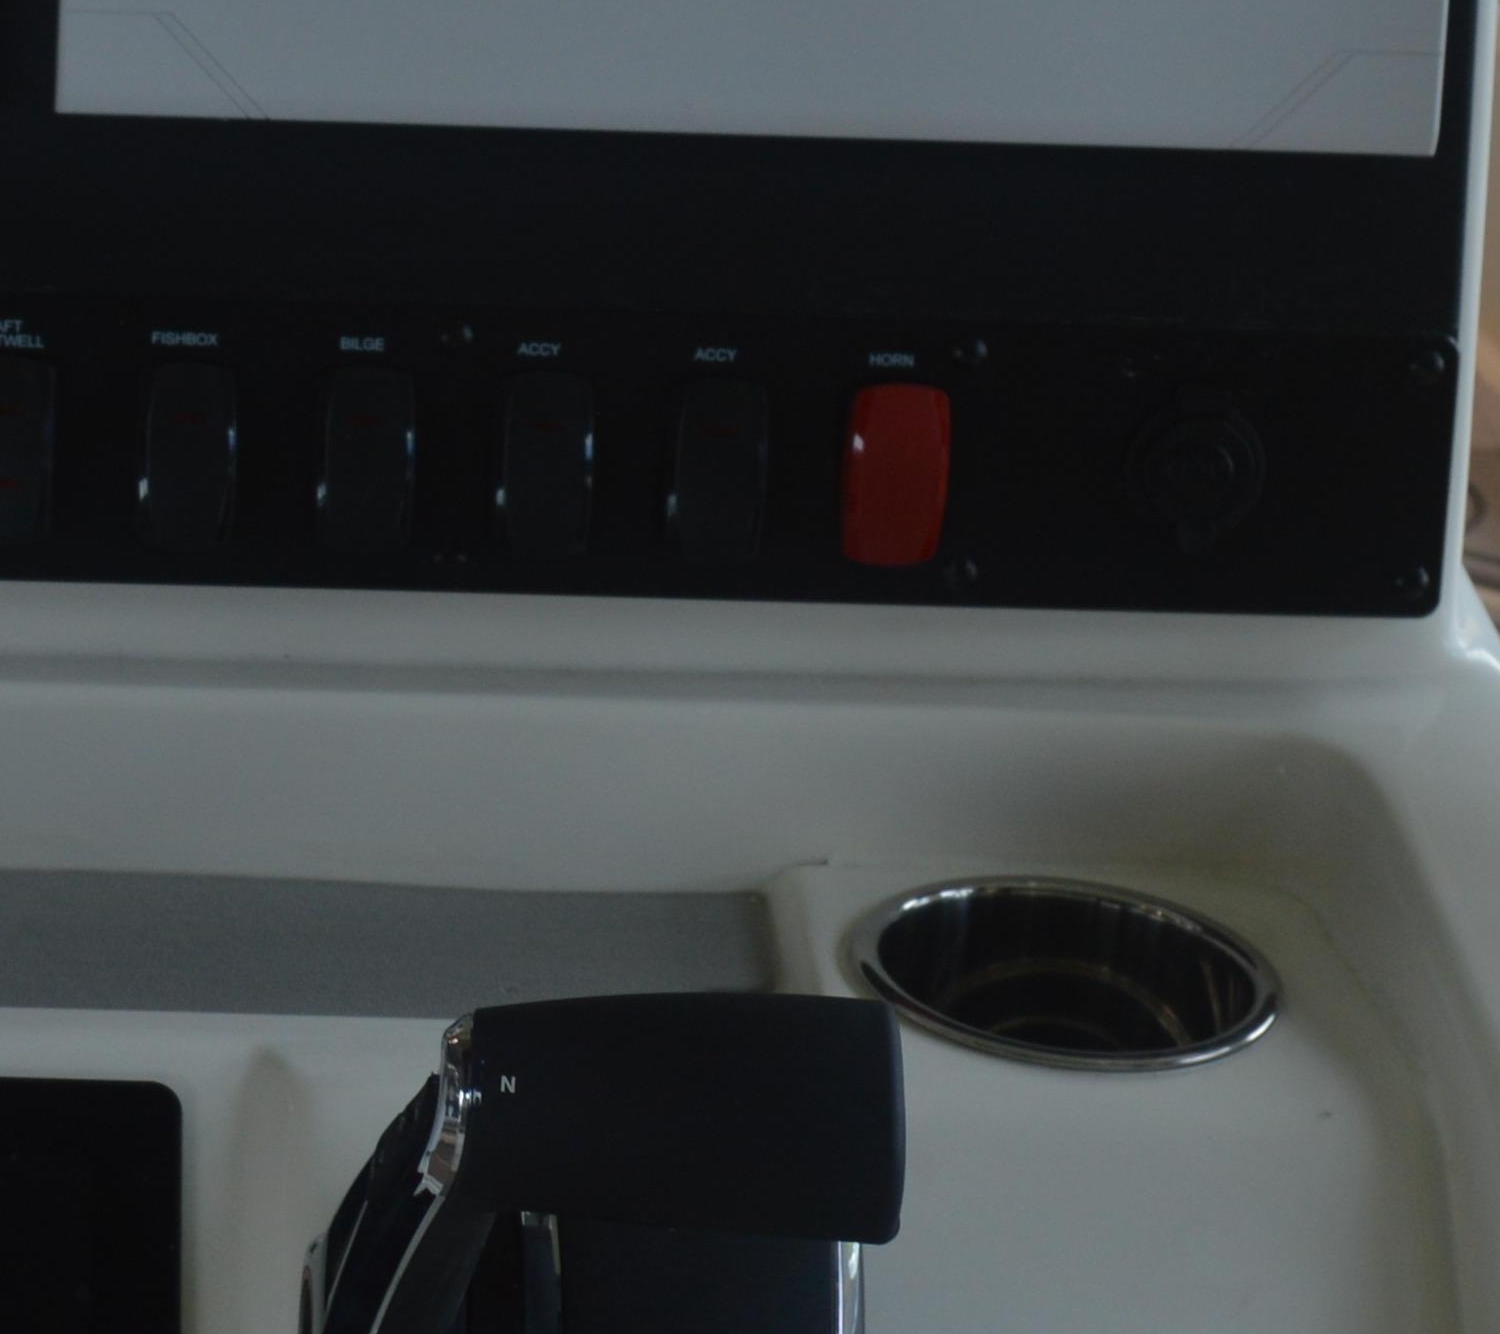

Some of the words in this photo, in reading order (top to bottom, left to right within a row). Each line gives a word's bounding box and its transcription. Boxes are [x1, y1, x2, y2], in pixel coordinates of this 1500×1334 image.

[151, 330, 219, 346] FISHBOX
[339, 336, 385, 351] BILGE
[517, 343, 560, 358] ACCY
[694, 347, 737, 363] ACCY
[868, 352, 915, 368] HORN
[500, 1074, 516, 1094] N
